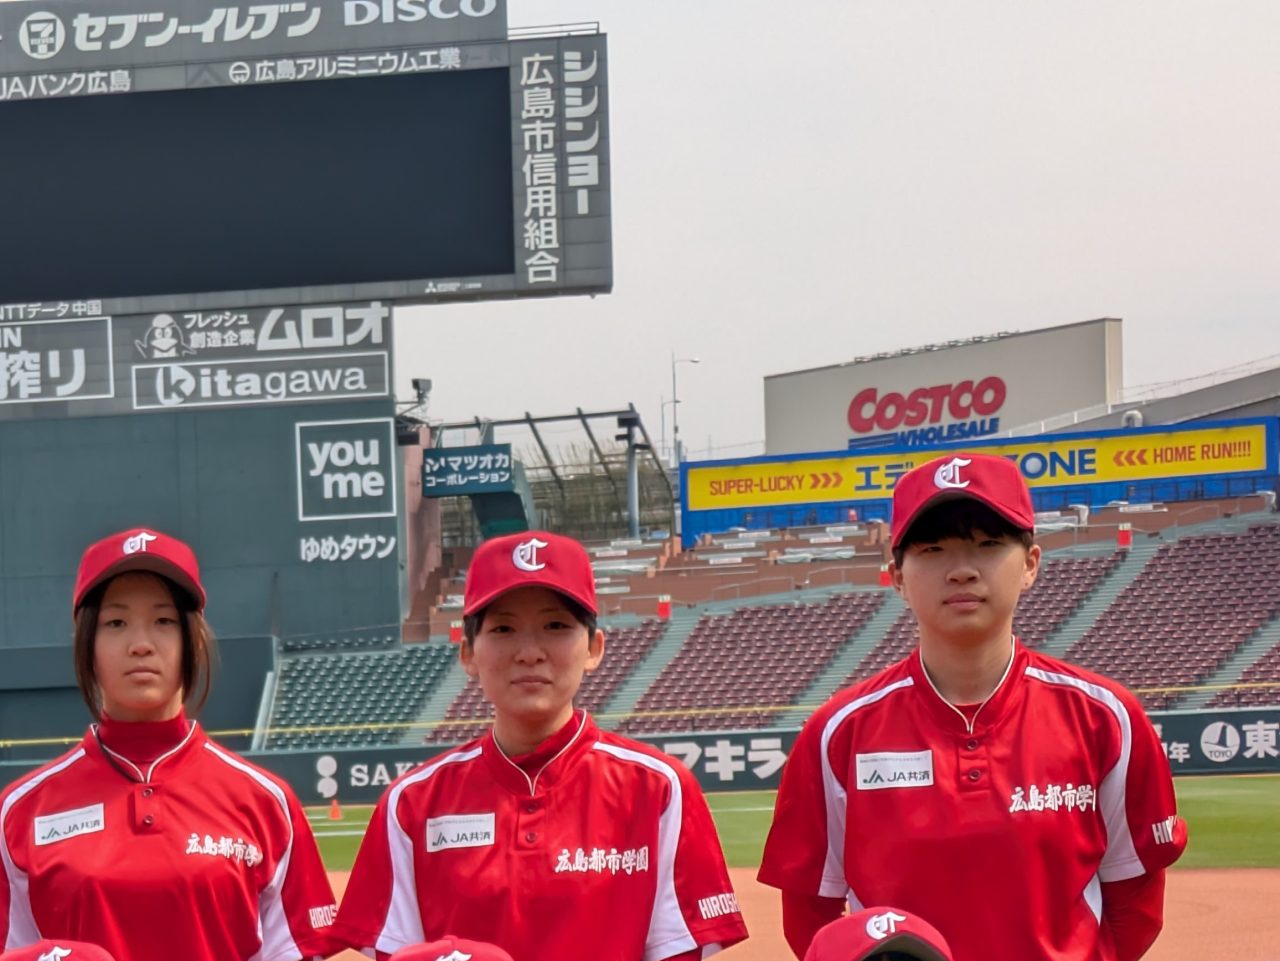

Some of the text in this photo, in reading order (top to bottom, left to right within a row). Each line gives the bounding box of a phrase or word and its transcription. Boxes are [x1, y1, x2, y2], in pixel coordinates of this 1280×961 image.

[344, 0, 496, 27] DISCO
[254, 47, 461, 82] 広島アルミニウム工業
[520, 53, 560, 284] 広島市信用組合
[184, 301, 390, 351] フレッシュ ムロオ
[190, 329, 256, 349] 創造企業
[848, 376, 1007, 433] COSTCO
[894, 417, 1000, 446] WHOLESALE
[308, 439, 380, 477] you
[447, 452, 510, 472] マツオカ
[1006, 448, 1097, 480] ONE
[1153, 446, 1196, 465] HOME
[323, 470, 385, 499] me
[709, 474, 805, 496] SUPER-LUCKY
[301, 534, 396, 562] ゆめタウン
[1209, 749, 1232, 759] TOYO
[1009, 783, 1096, 813] 広島都市学
[554, 846, 649, 875] 広島都市学園
